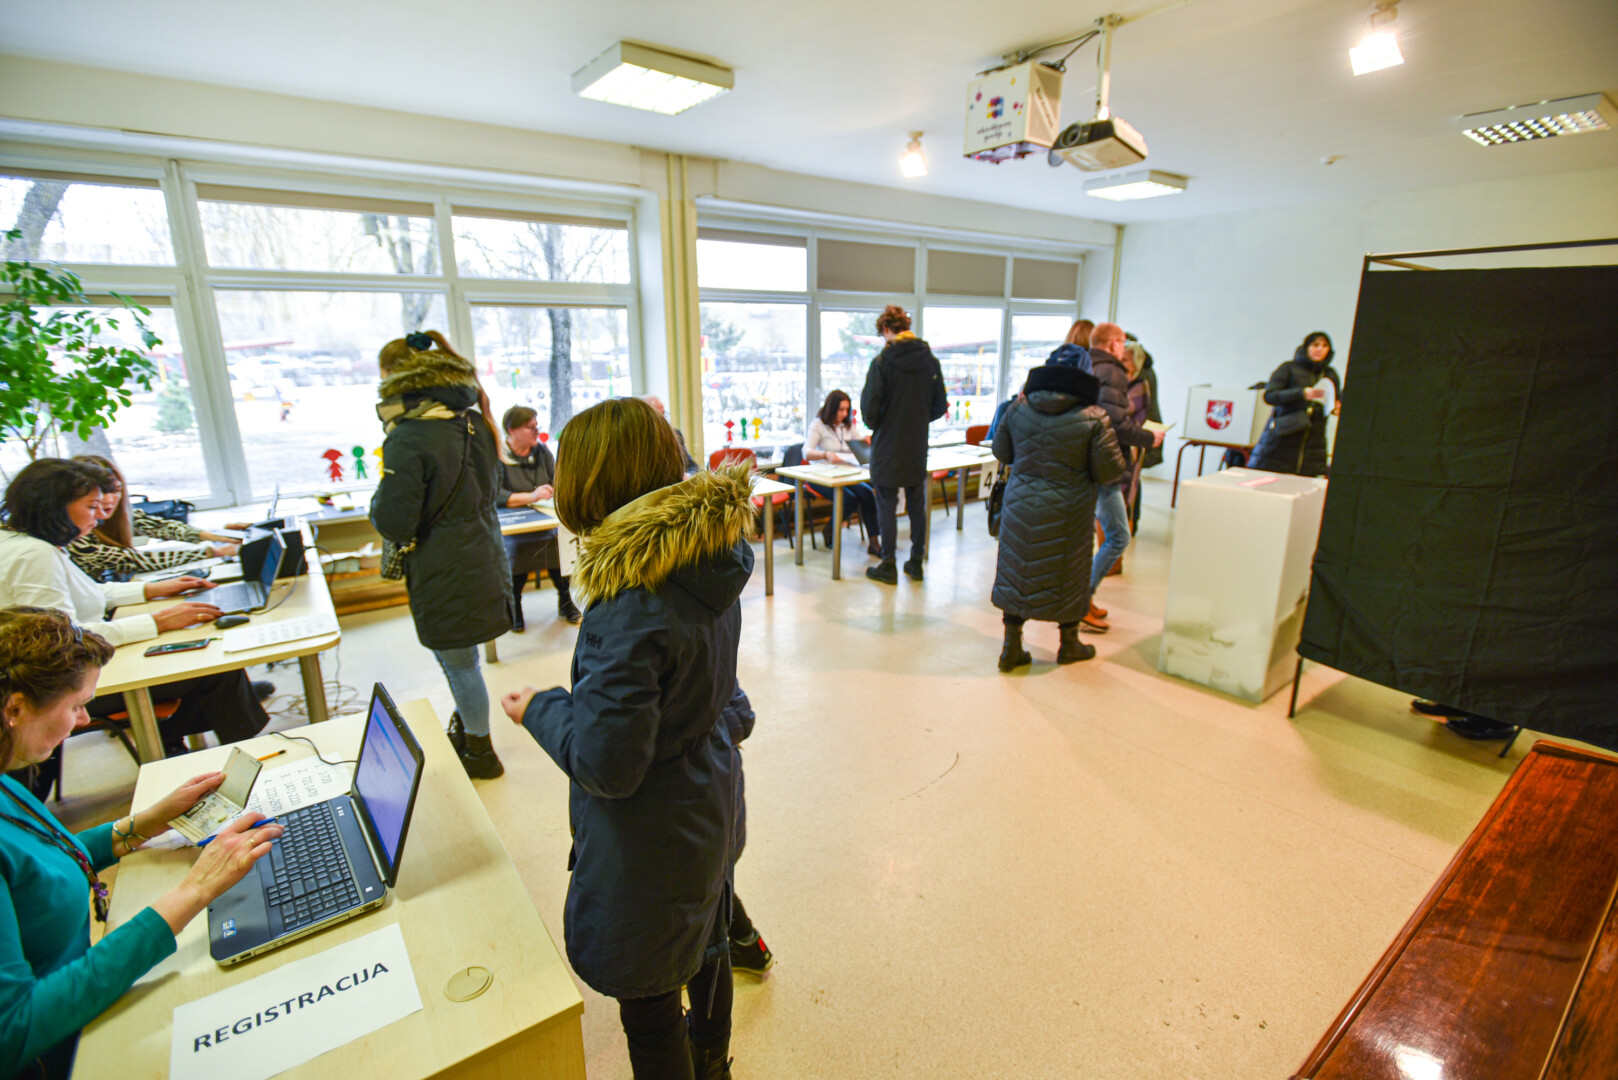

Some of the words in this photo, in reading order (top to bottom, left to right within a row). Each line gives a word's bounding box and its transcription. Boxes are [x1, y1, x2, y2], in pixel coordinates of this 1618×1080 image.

[984, 471, 993, 490] 4
[585, 632, 603, 649] HH
[193, 962, 389, 1053] REGISTRACIJA
